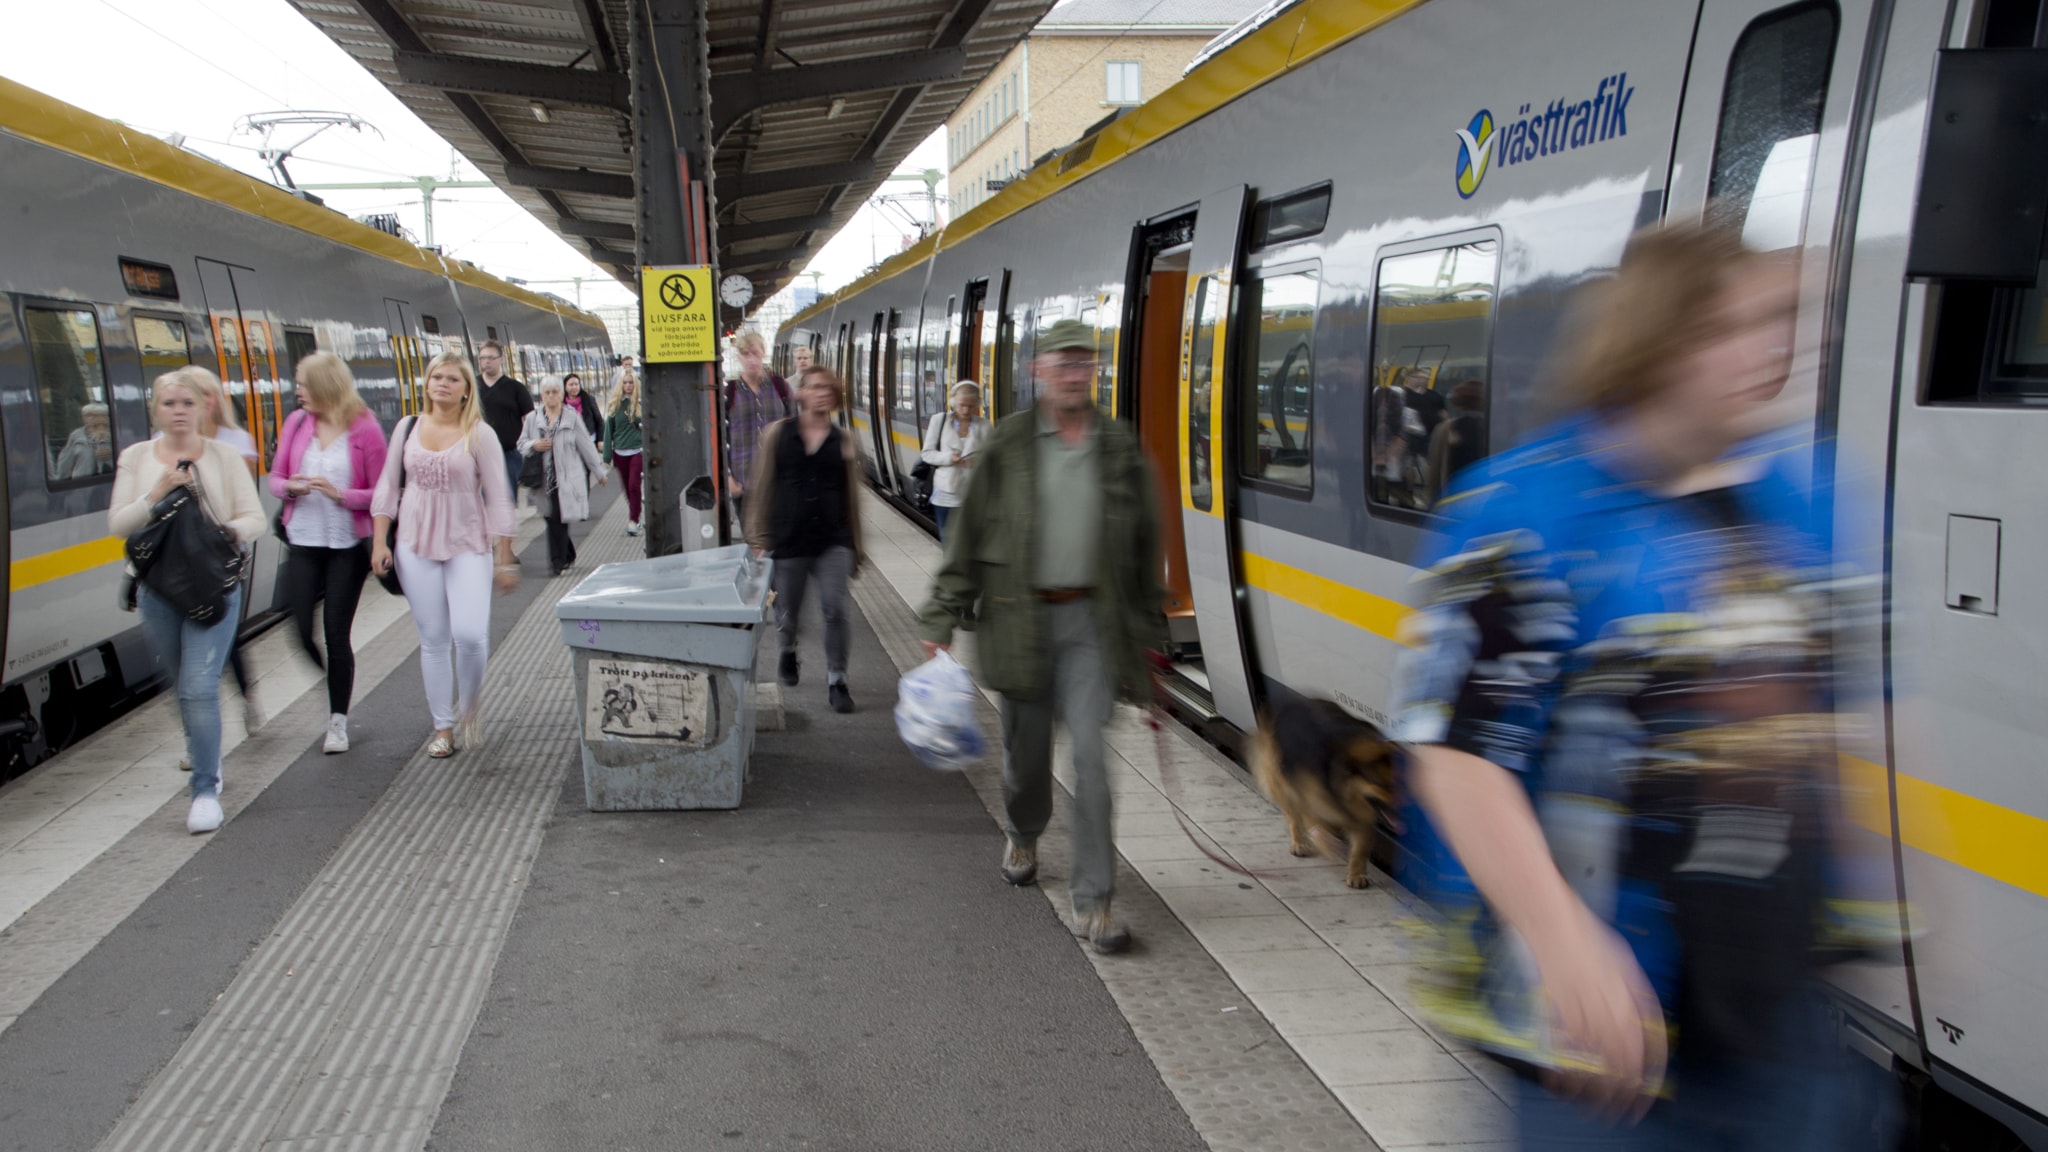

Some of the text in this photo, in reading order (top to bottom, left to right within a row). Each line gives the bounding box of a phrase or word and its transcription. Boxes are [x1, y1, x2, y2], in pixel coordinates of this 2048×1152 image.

[1498, 72, 1635, 168] västtrafik
[650, 313, 707, 323] LIVSFARA
[651, 669, 697, 681] krisen?
